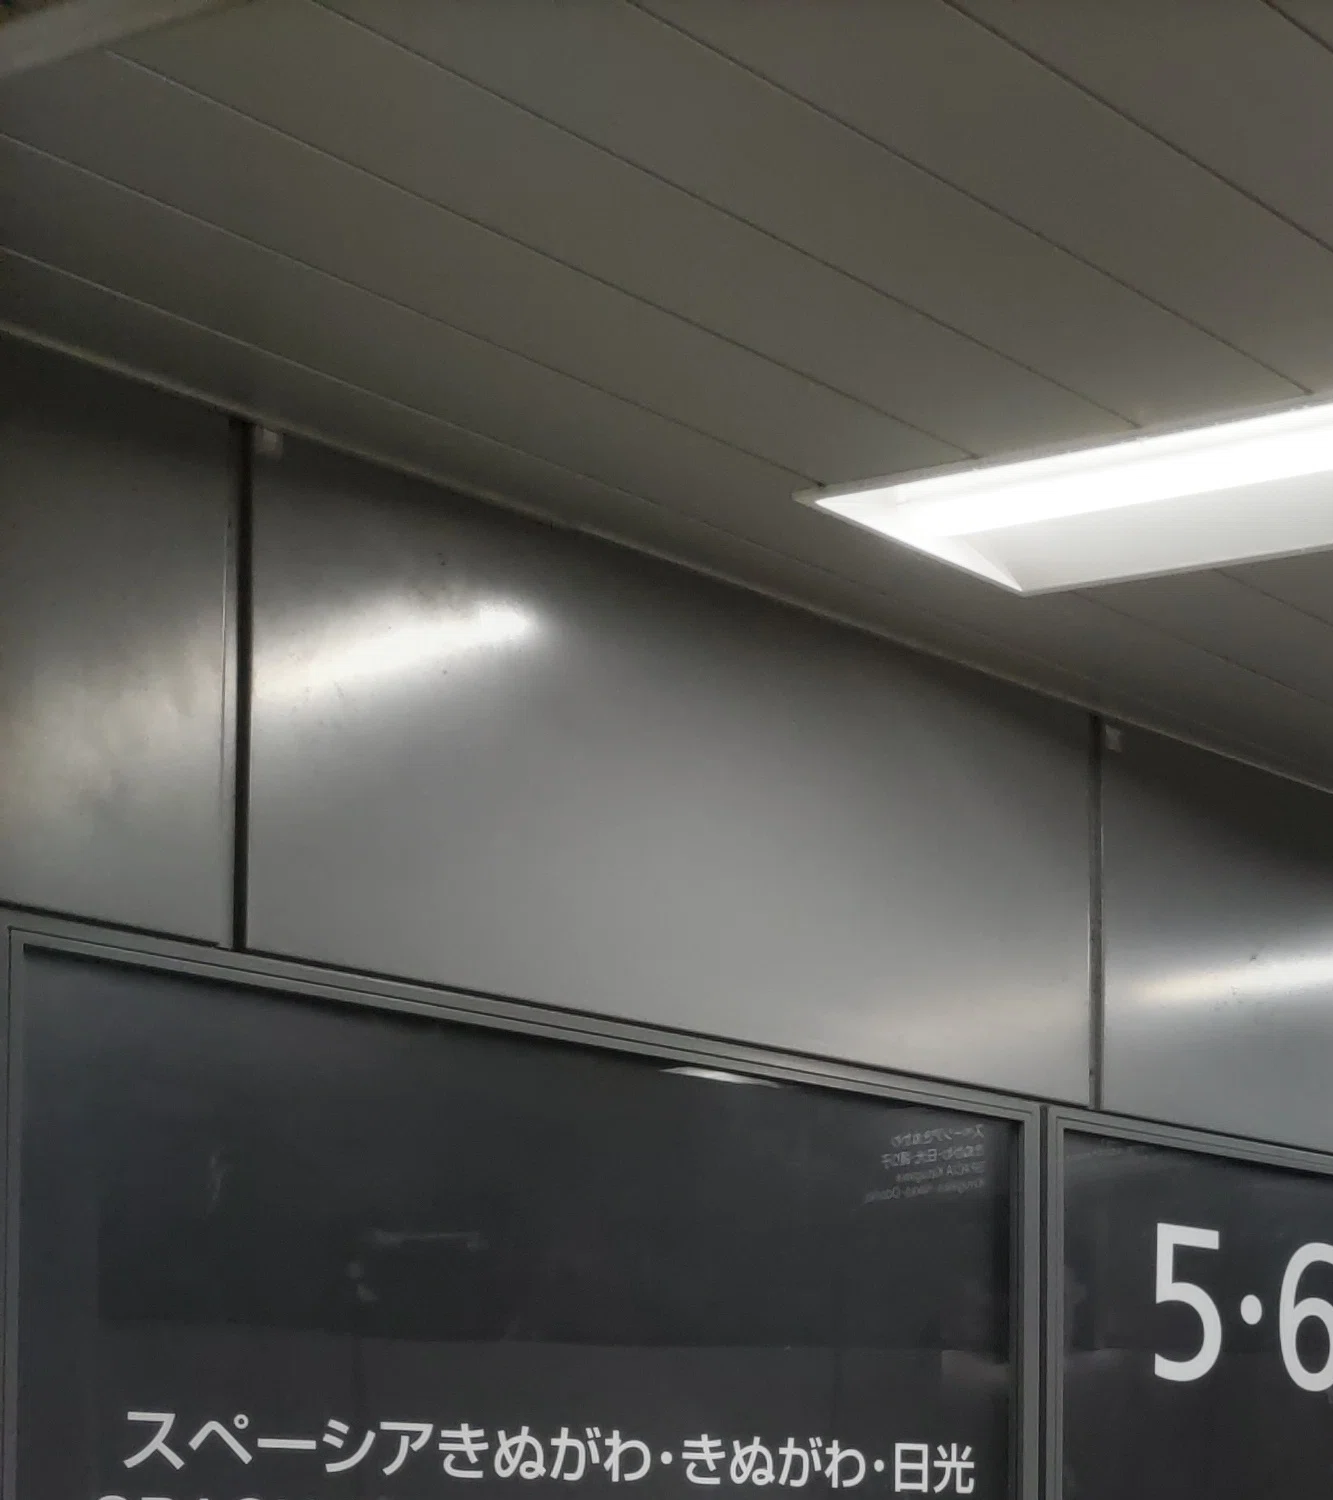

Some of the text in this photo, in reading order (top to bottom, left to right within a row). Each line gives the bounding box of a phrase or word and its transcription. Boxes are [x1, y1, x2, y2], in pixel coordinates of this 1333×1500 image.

[124, 1412, 974, 1493] スペーシアきぬがわ・きぬがわ・日光
